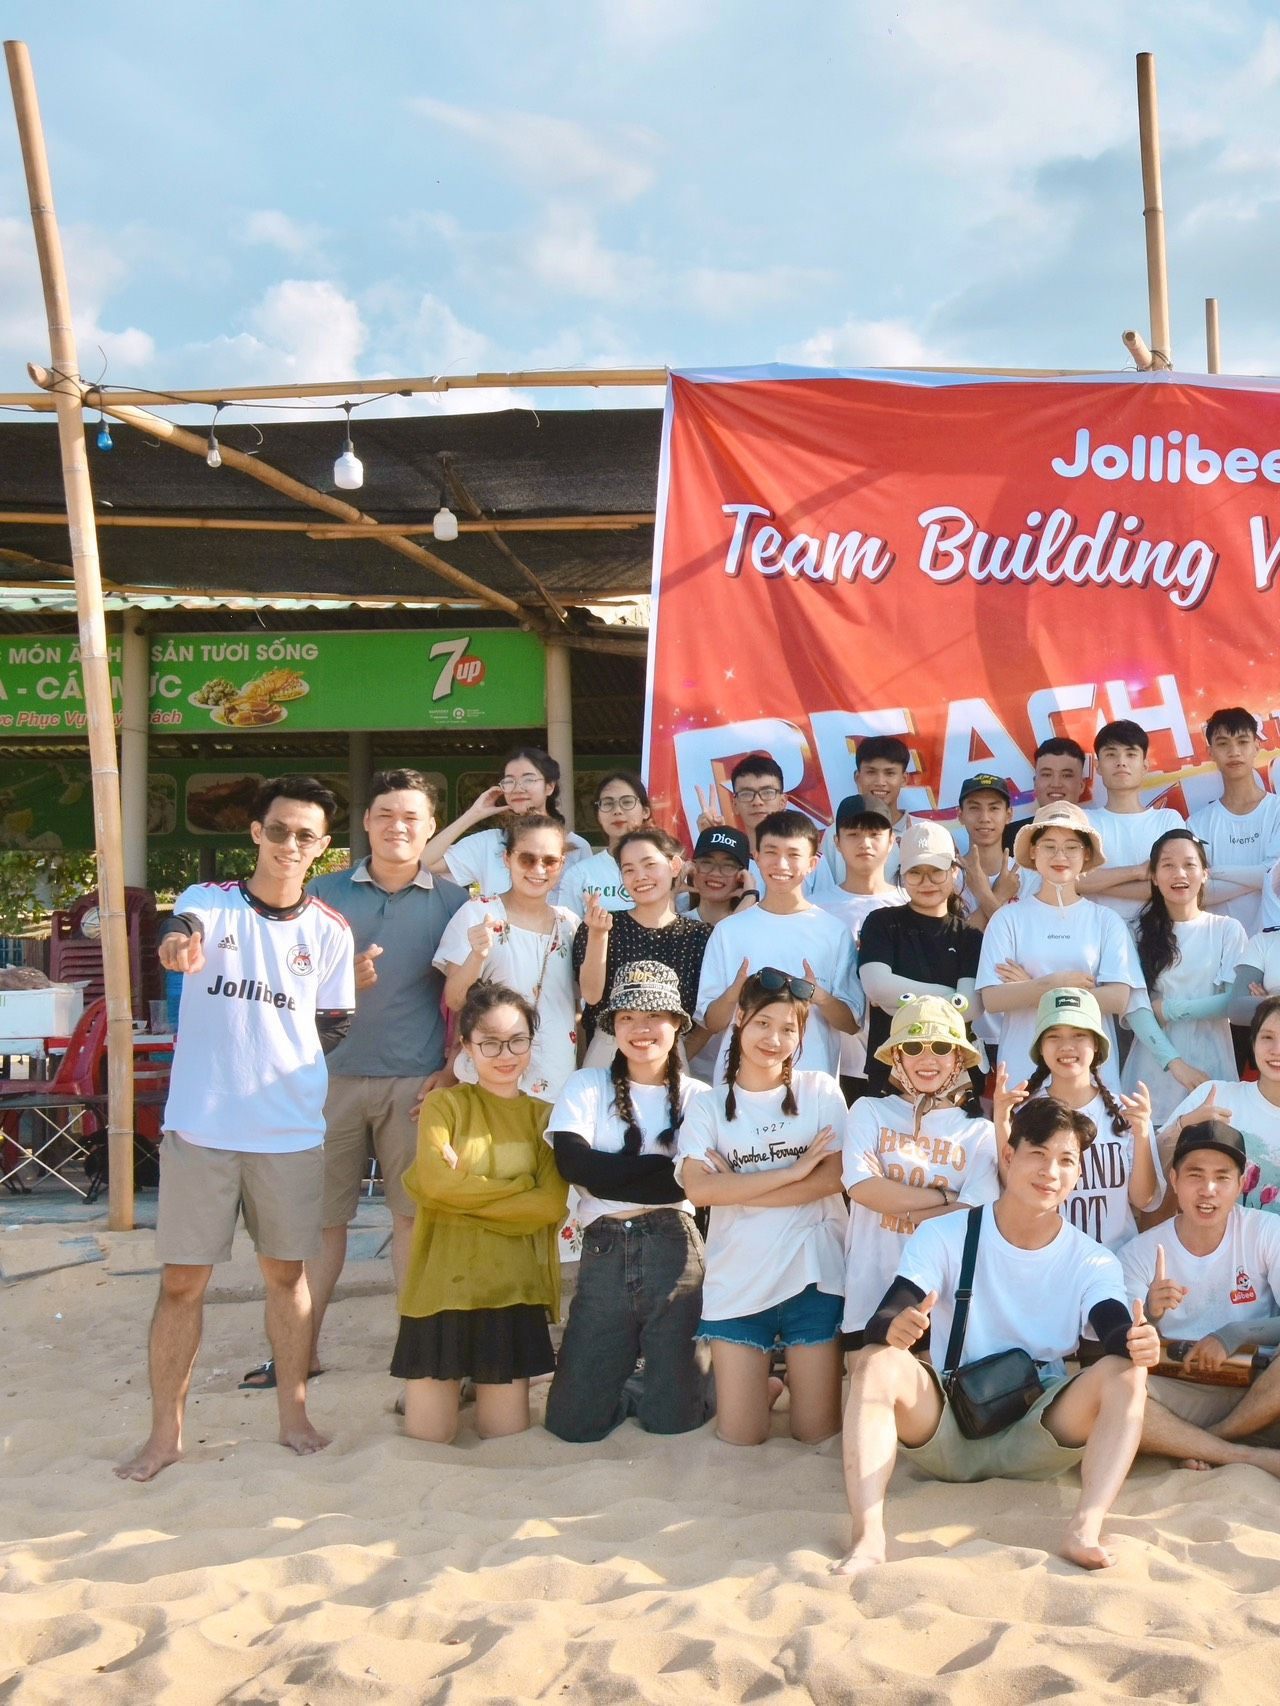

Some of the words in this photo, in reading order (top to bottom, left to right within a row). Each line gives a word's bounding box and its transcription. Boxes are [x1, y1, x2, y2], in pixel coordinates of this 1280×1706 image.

[722, 504, 895, 584] Team
[917, 506, 1218, 610] Building
[9, 643, 61, 664] MÓN
[151, 640, 194, 663] SẢN
[201, 642, 249, 663] TƯƠI
[256, 637, 319, 661] SỐNG
[711, 833, 737, 847] Dior
